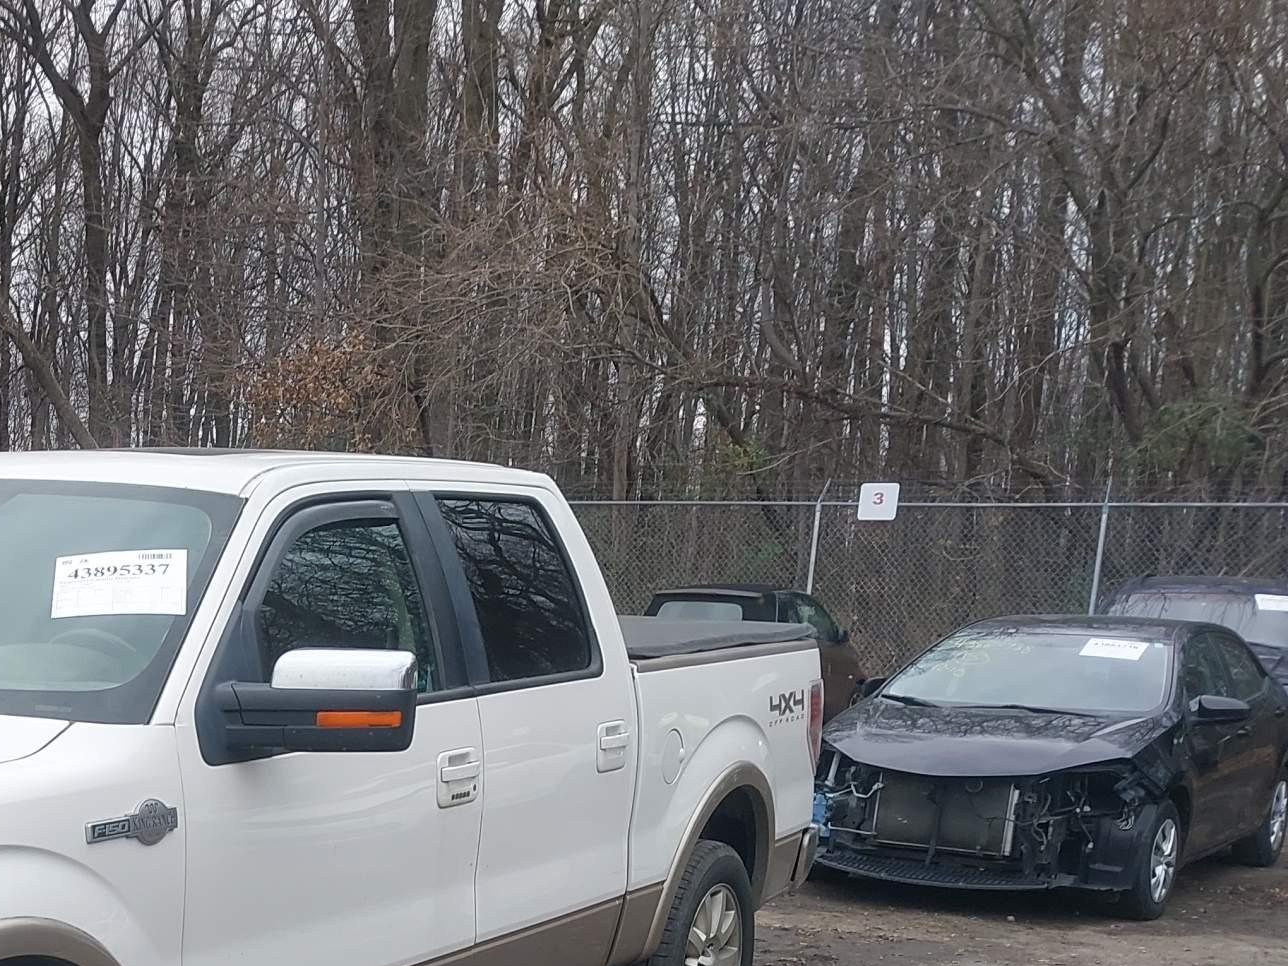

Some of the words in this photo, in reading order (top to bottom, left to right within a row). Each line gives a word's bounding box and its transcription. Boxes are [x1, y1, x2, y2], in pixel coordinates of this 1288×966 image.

[873, 492, 884, 505] 3
[67, 564, 170, 580] 43895337
[94, 820, 129, 839] F-150
